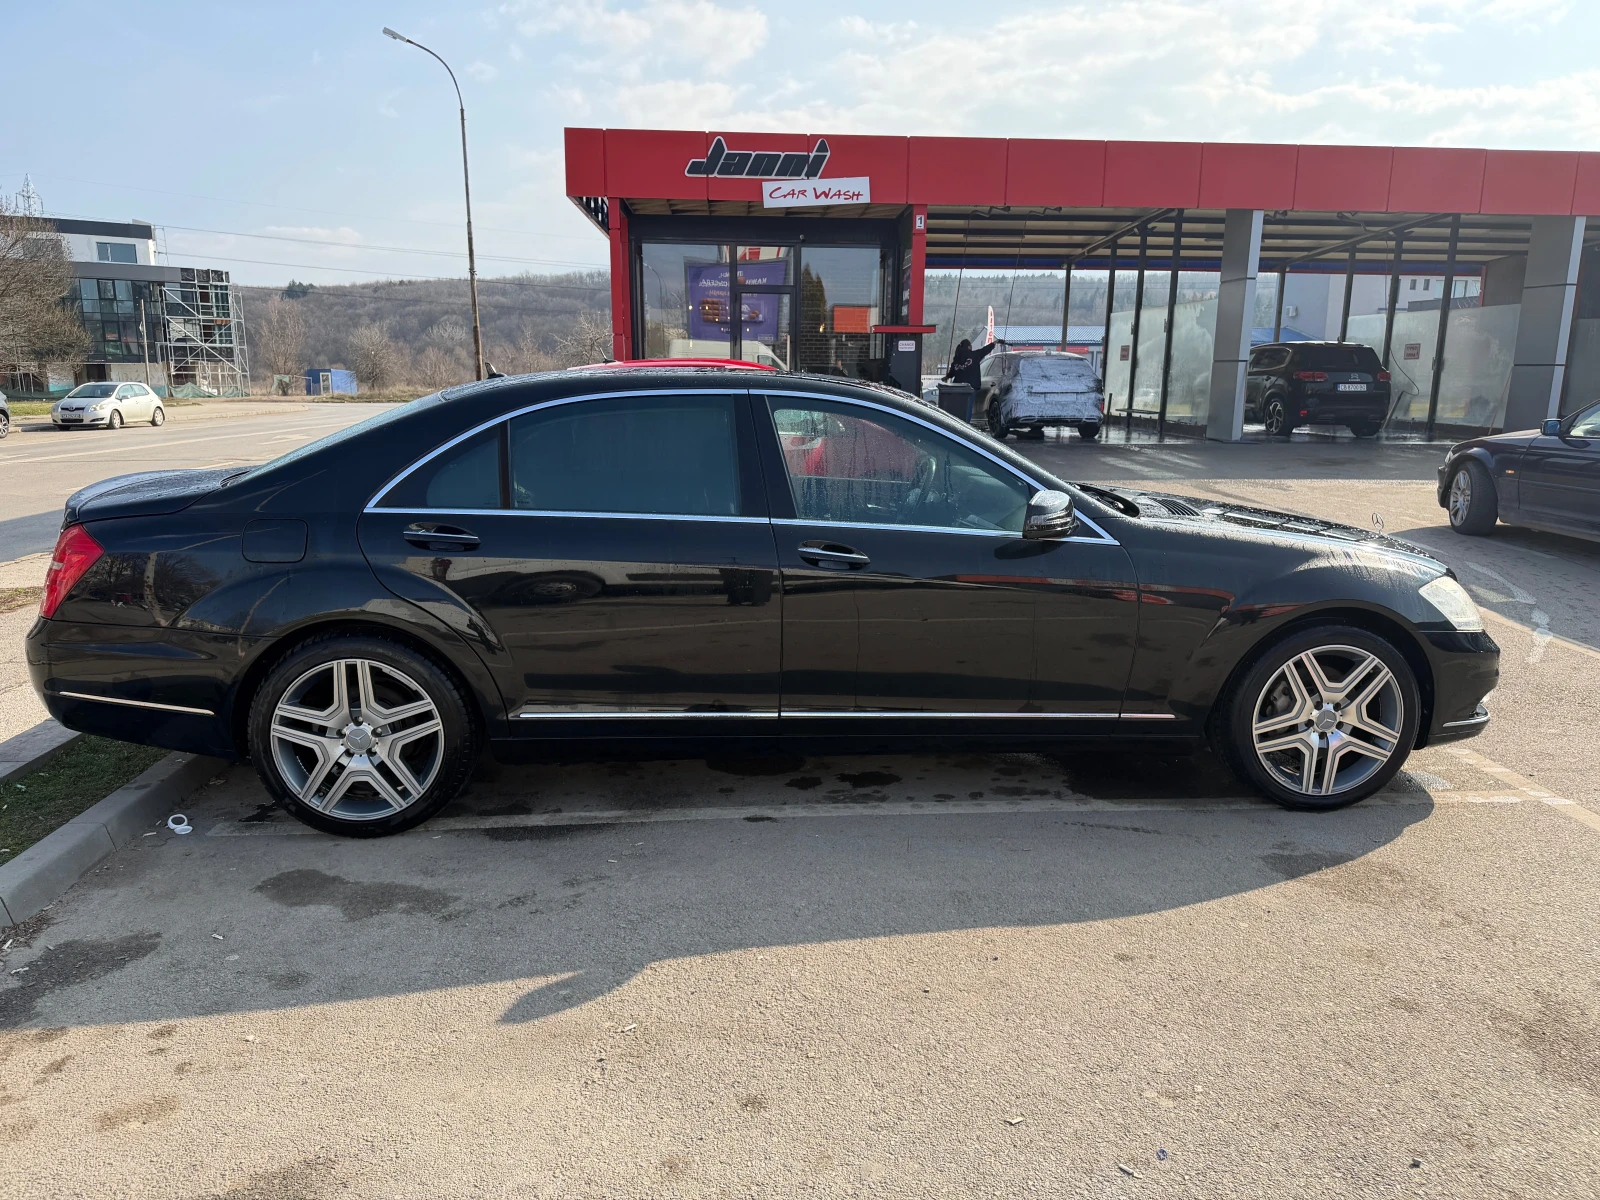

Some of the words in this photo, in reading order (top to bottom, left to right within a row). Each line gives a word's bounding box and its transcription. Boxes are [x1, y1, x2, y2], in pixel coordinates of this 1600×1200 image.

[685, 136, 830, 179] Janni
[769, 186, 808, 200] CAR
[813, 186, 864, 201] WASH
